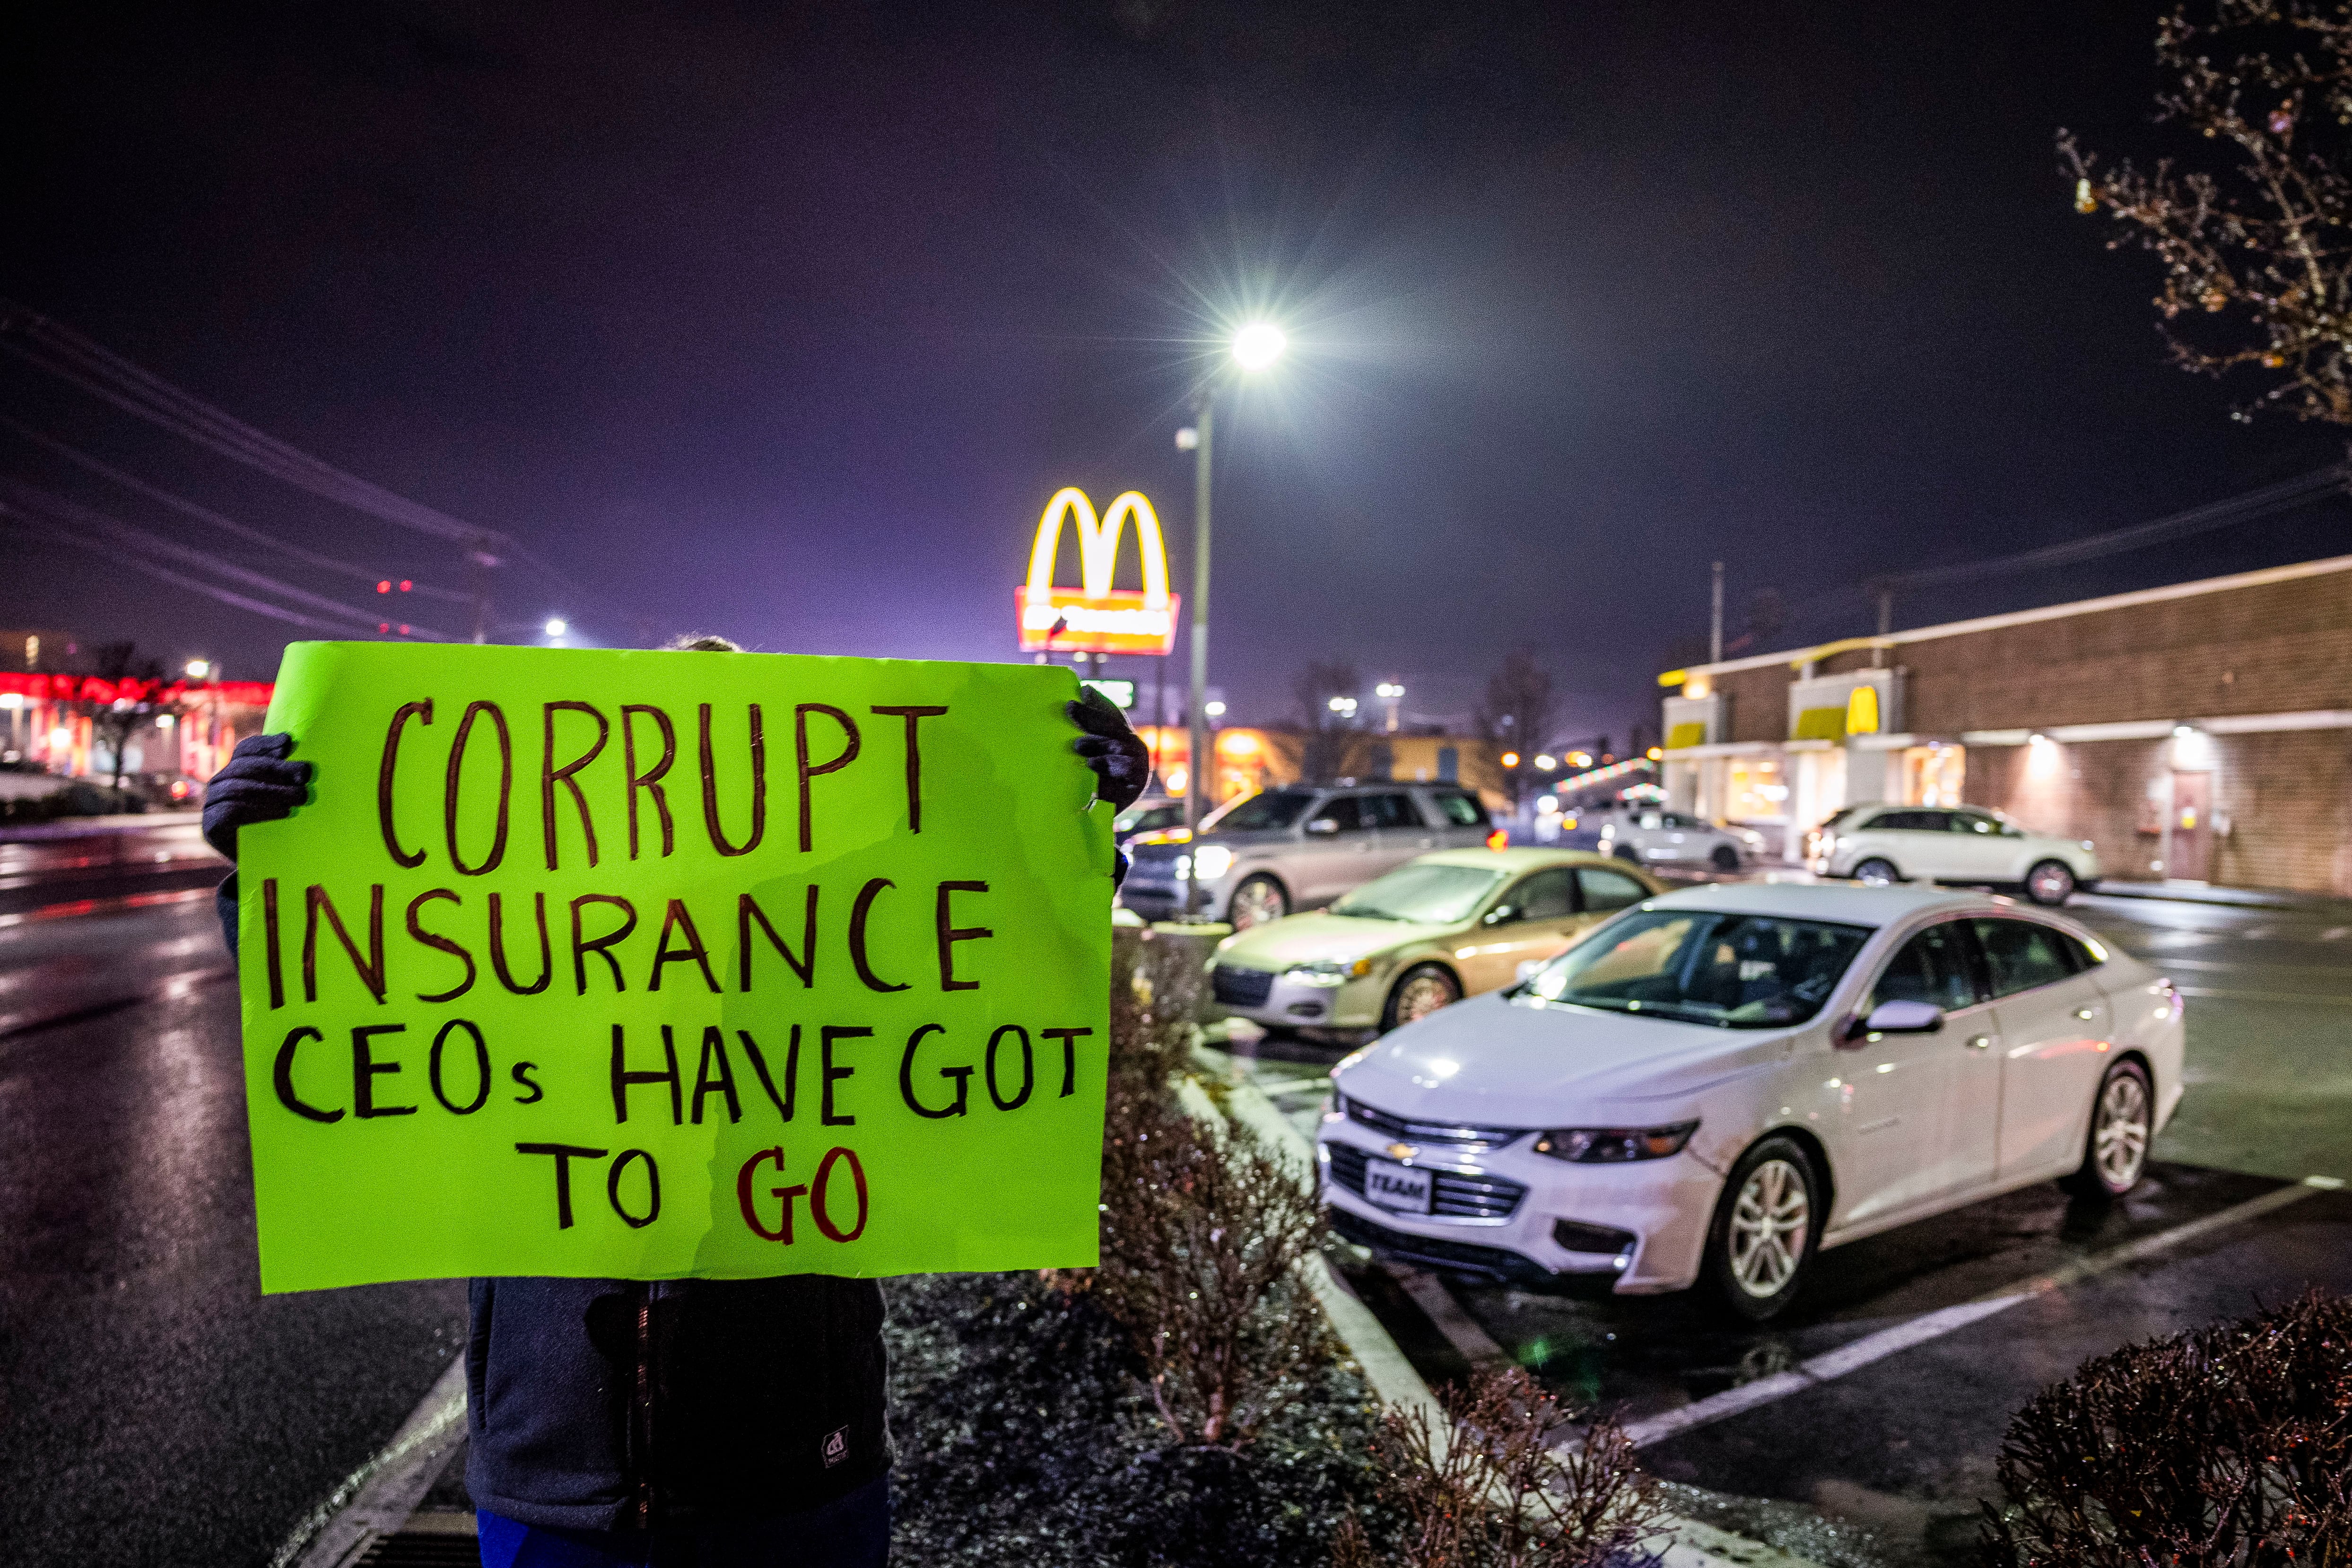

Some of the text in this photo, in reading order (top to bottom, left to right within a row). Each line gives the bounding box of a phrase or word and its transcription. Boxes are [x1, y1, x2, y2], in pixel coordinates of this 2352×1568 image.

[378, 697, 950, 876] CORRUPT
[262, 877, 994, 1011] INSURANCE
[272, 1019, 1094, 1127] CEOs HAVE GOT
[514, 1142, 869, 1247] TO GO
[1372, 1173, 1424, 1198] TEAM
